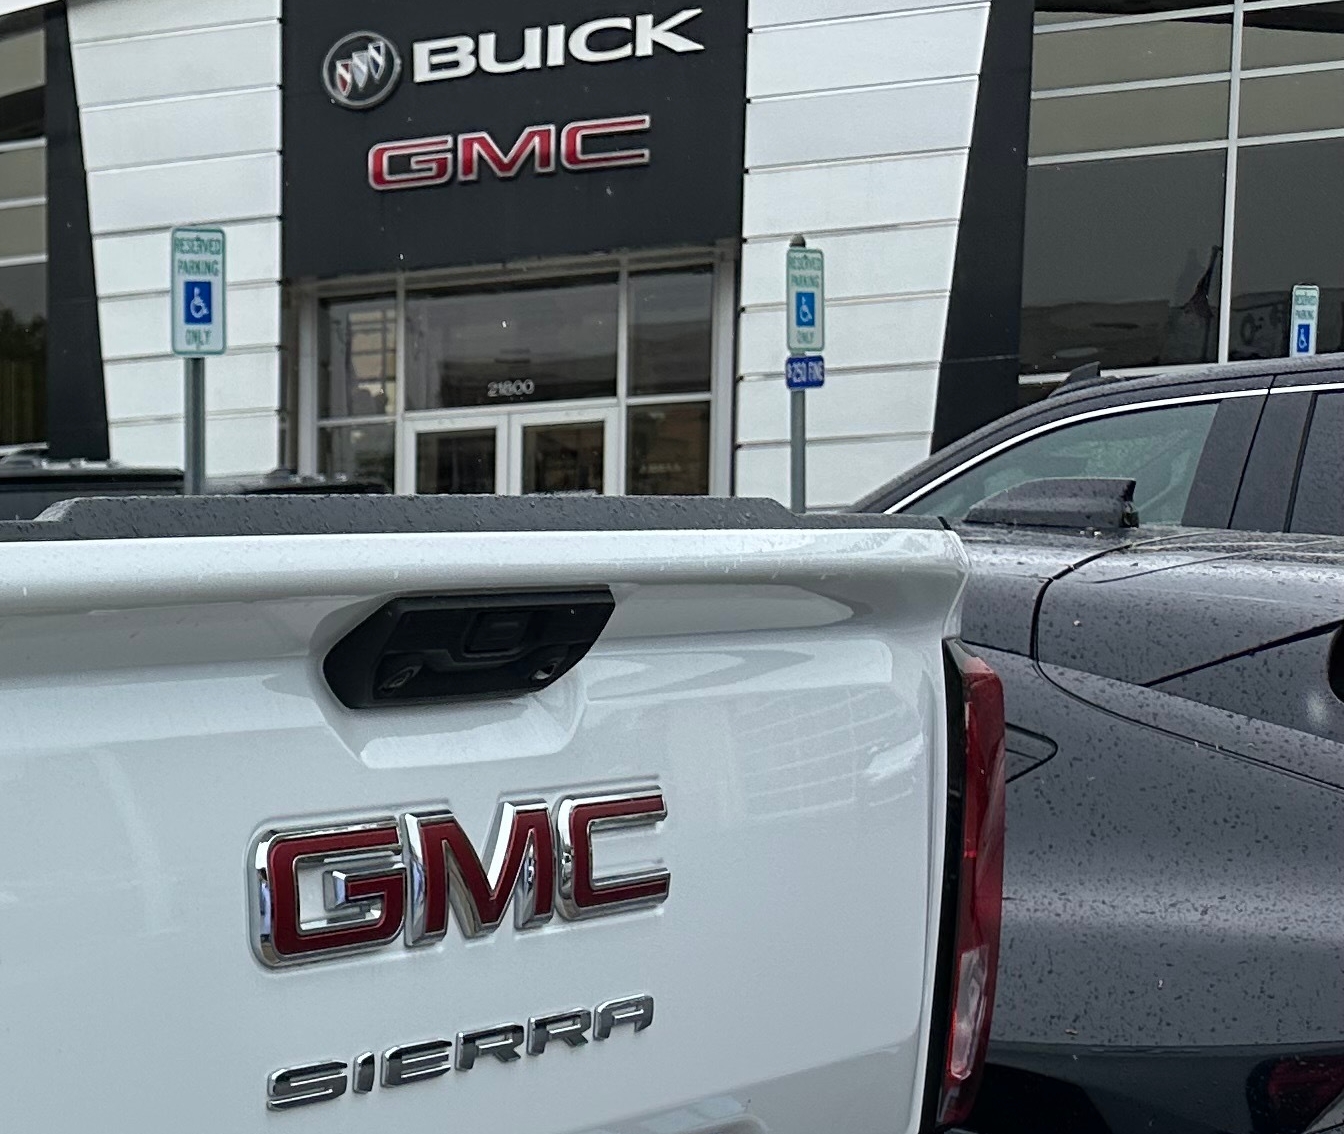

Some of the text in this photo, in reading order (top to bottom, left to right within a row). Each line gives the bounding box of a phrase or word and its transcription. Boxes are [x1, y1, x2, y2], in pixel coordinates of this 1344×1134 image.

[413, 8, 705, 83] BUICK
[368, 114, 651, 191] GMC
[174, 238, 222, 255] RESERVED
[177, 259, 219, 276] PARKING
[185, 328, 211, 346] ONLY
[487, 379, 535, 397] 21800
[253, 784, 671, 967] GMC
[266, 994, 654, 1112] SIERRA
